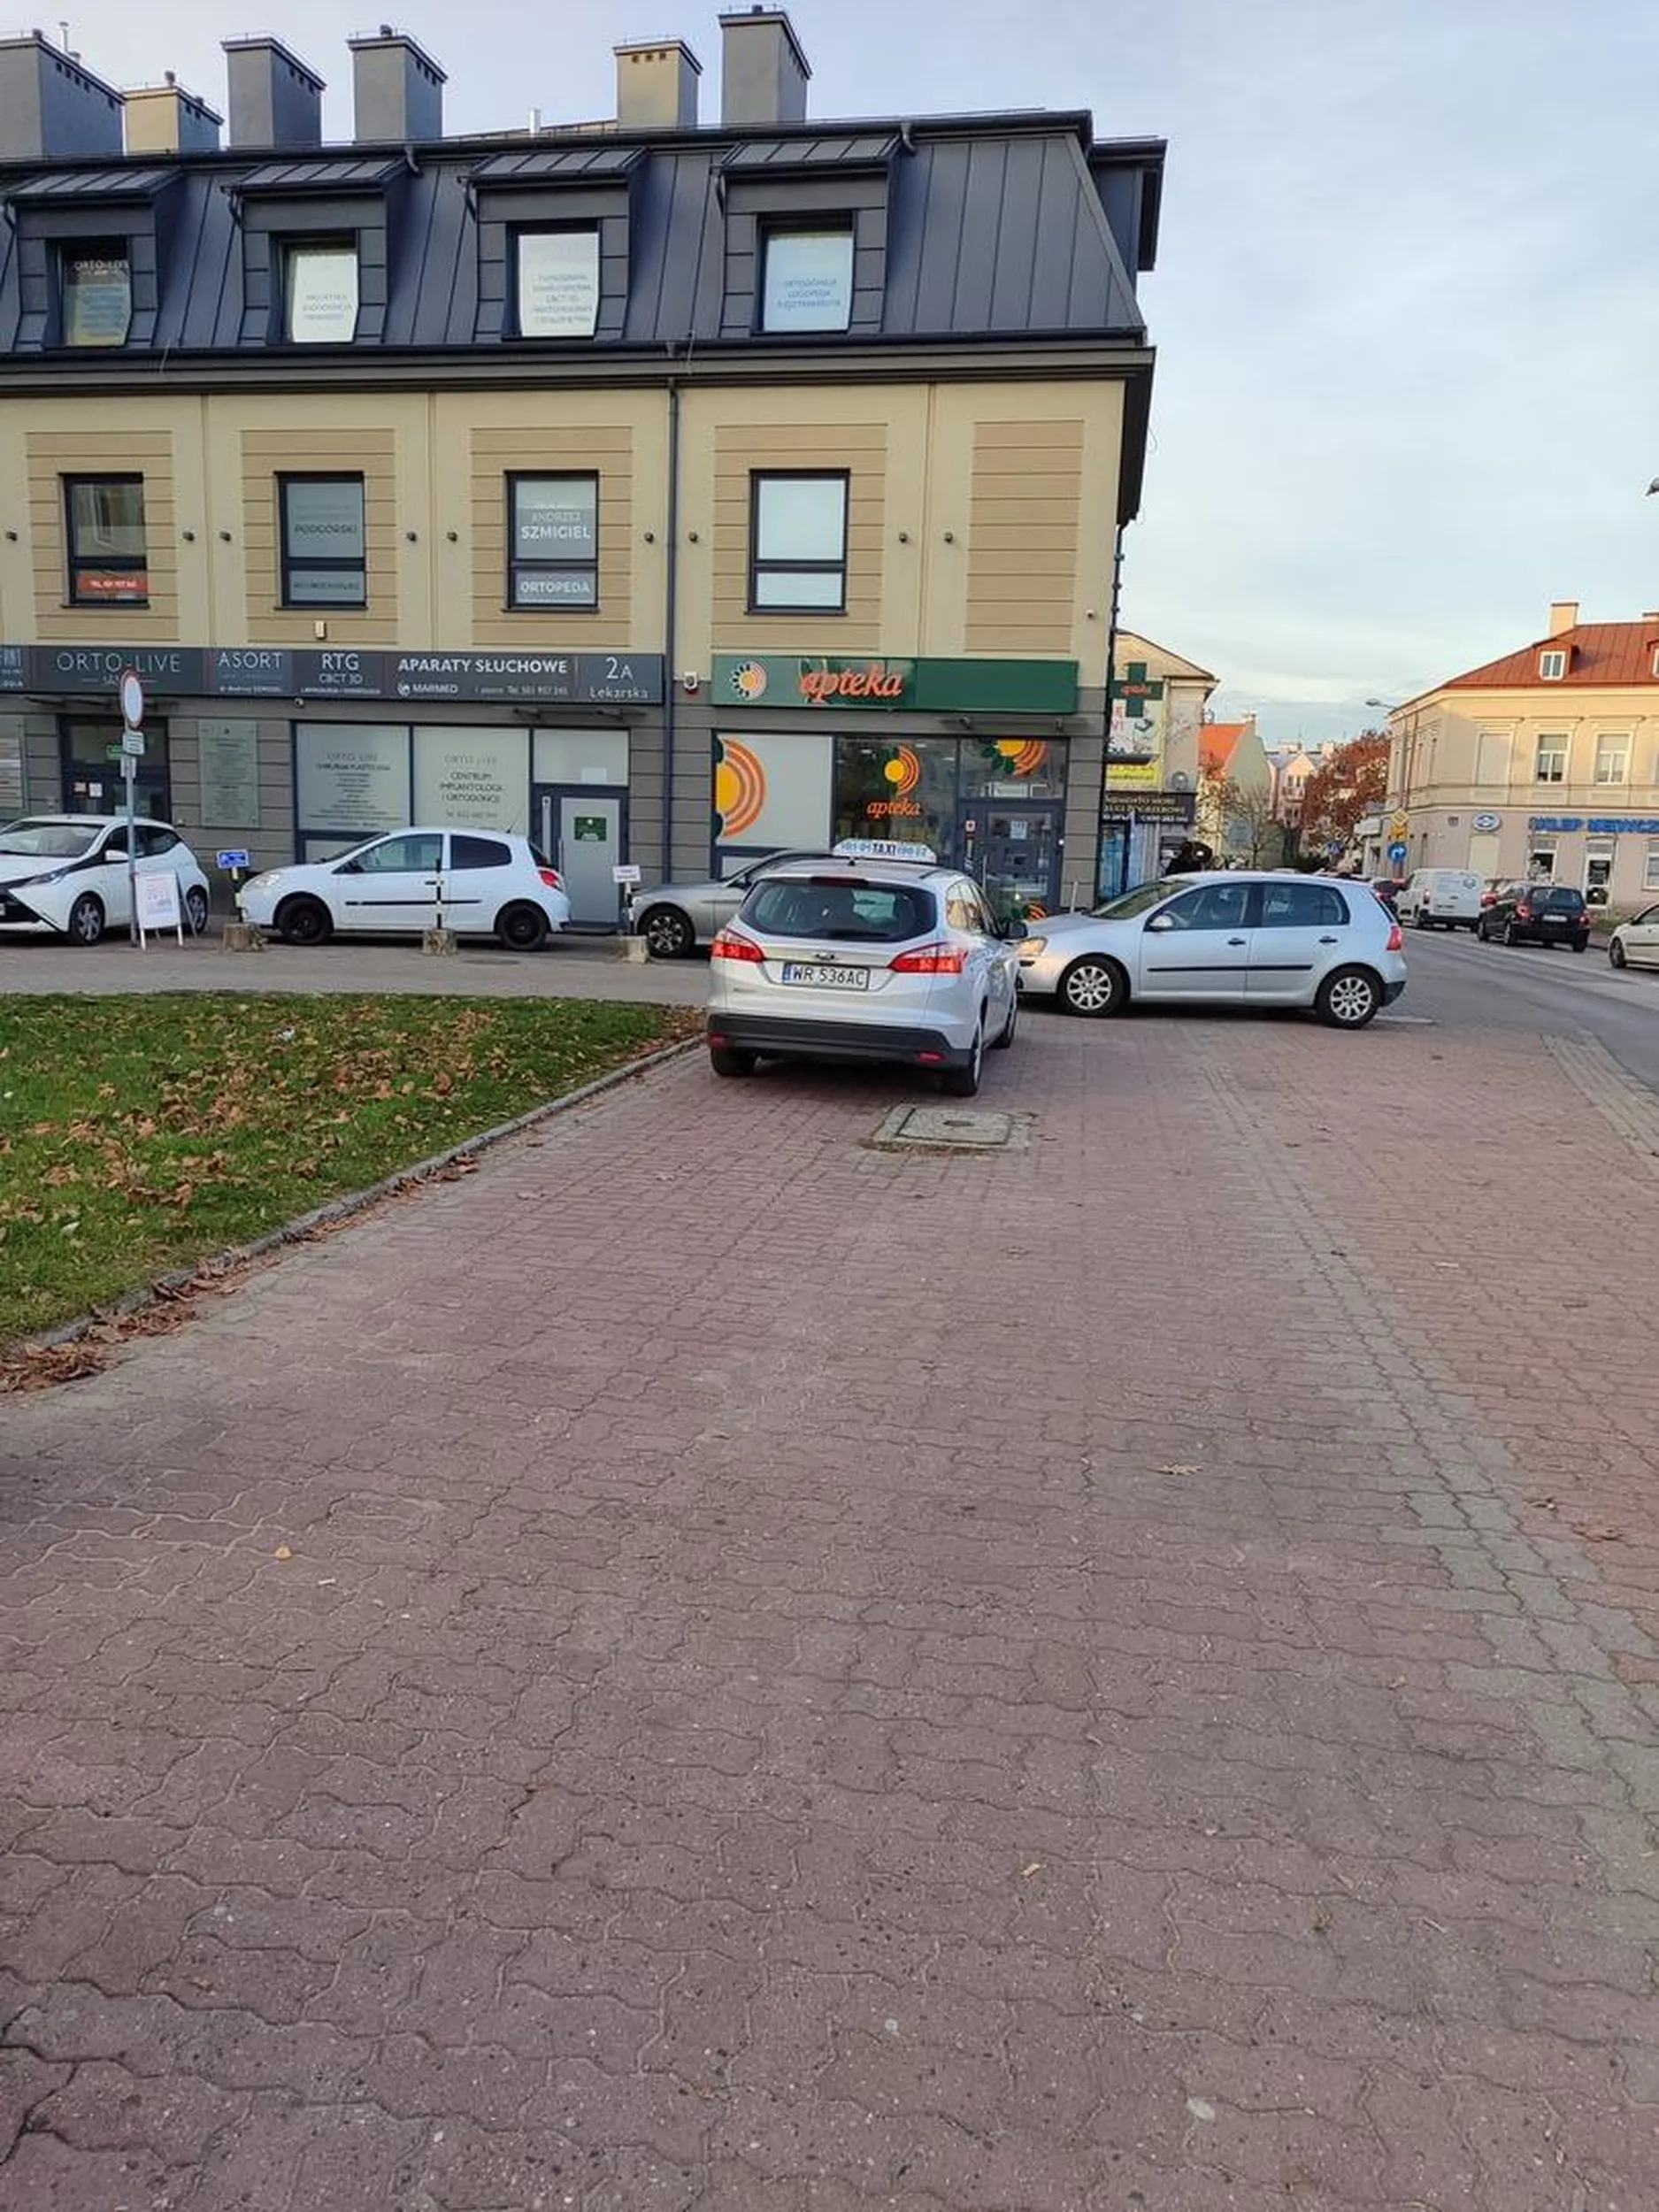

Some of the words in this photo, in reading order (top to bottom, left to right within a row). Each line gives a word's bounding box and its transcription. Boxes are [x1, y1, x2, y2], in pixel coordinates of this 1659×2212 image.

[520, 526, 591, 540] SZMIGIEL
[520, 580, 591, 594] ORTOPEDA
[218, 652, 283, 670] ASORT
[321, 653, 360, 671] RTG
[398, 658, 472, 672] APARATY
[474, 658, 569, 674] SŁUCHOWE
[589, 685, 649, 700] Lekarska
[799, 663, 902, 705] apteka
[867, 797, 922, 820] apteka
[872, 842, 896, 856] TAXI
[794, 966, 814, 981] WR
[819, 968, 864, 986] 536AC
